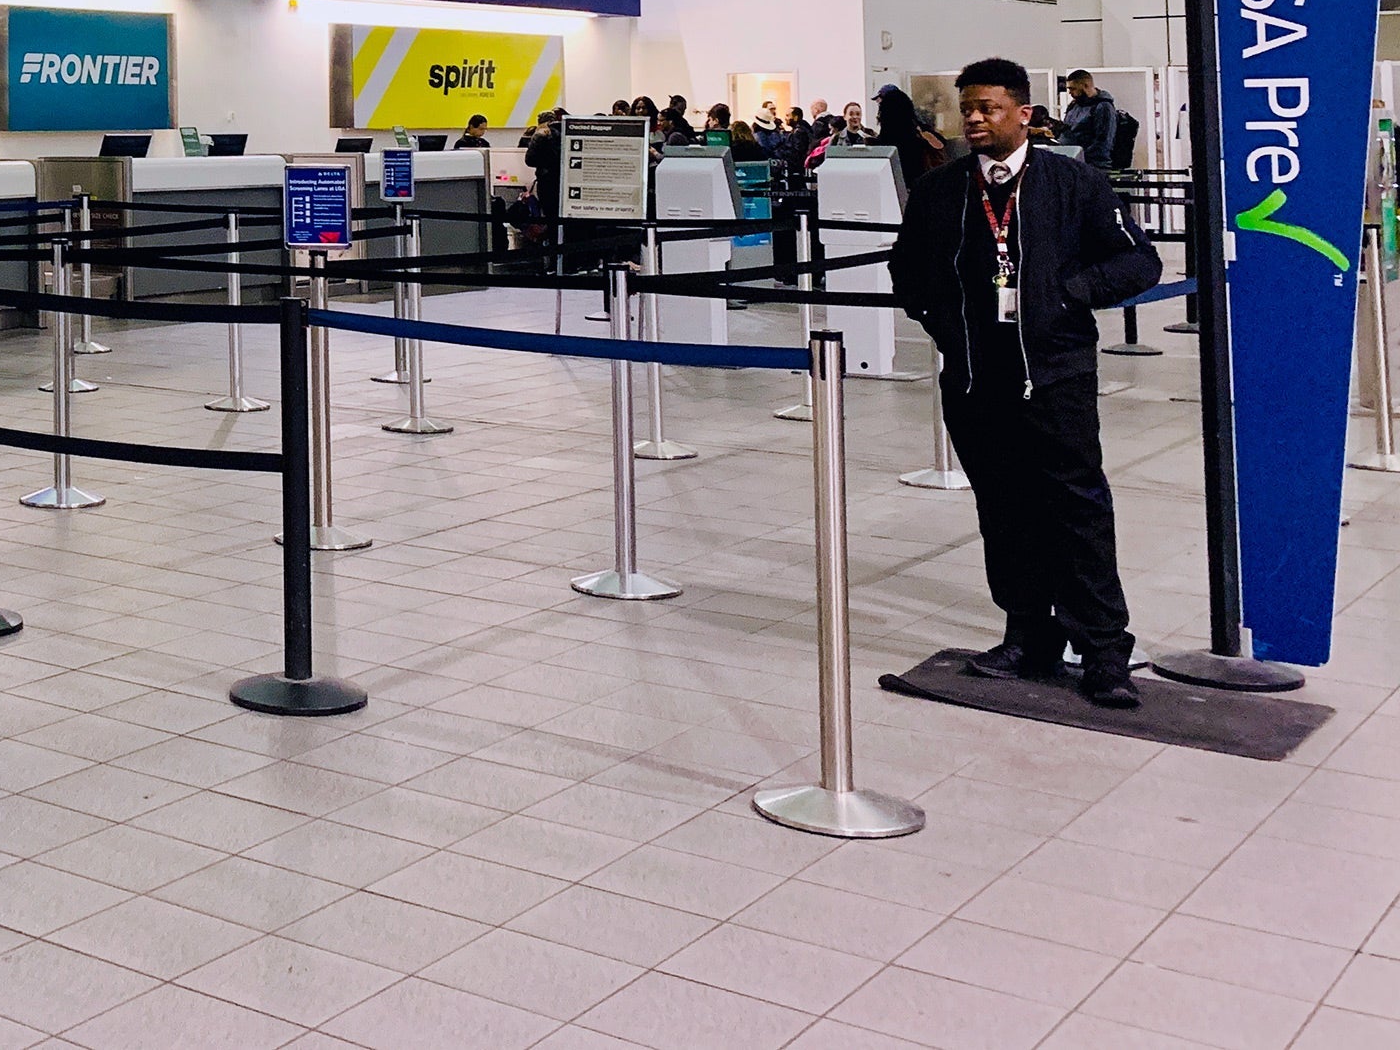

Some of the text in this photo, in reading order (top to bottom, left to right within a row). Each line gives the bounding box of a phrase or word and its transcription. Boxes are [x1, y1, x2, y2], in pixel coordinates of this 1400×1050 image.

[19, 52, 160, 86] FRONTIER
[428, 58, 496, 96] spirit
[1243, 77, 1310, 184] Pre
